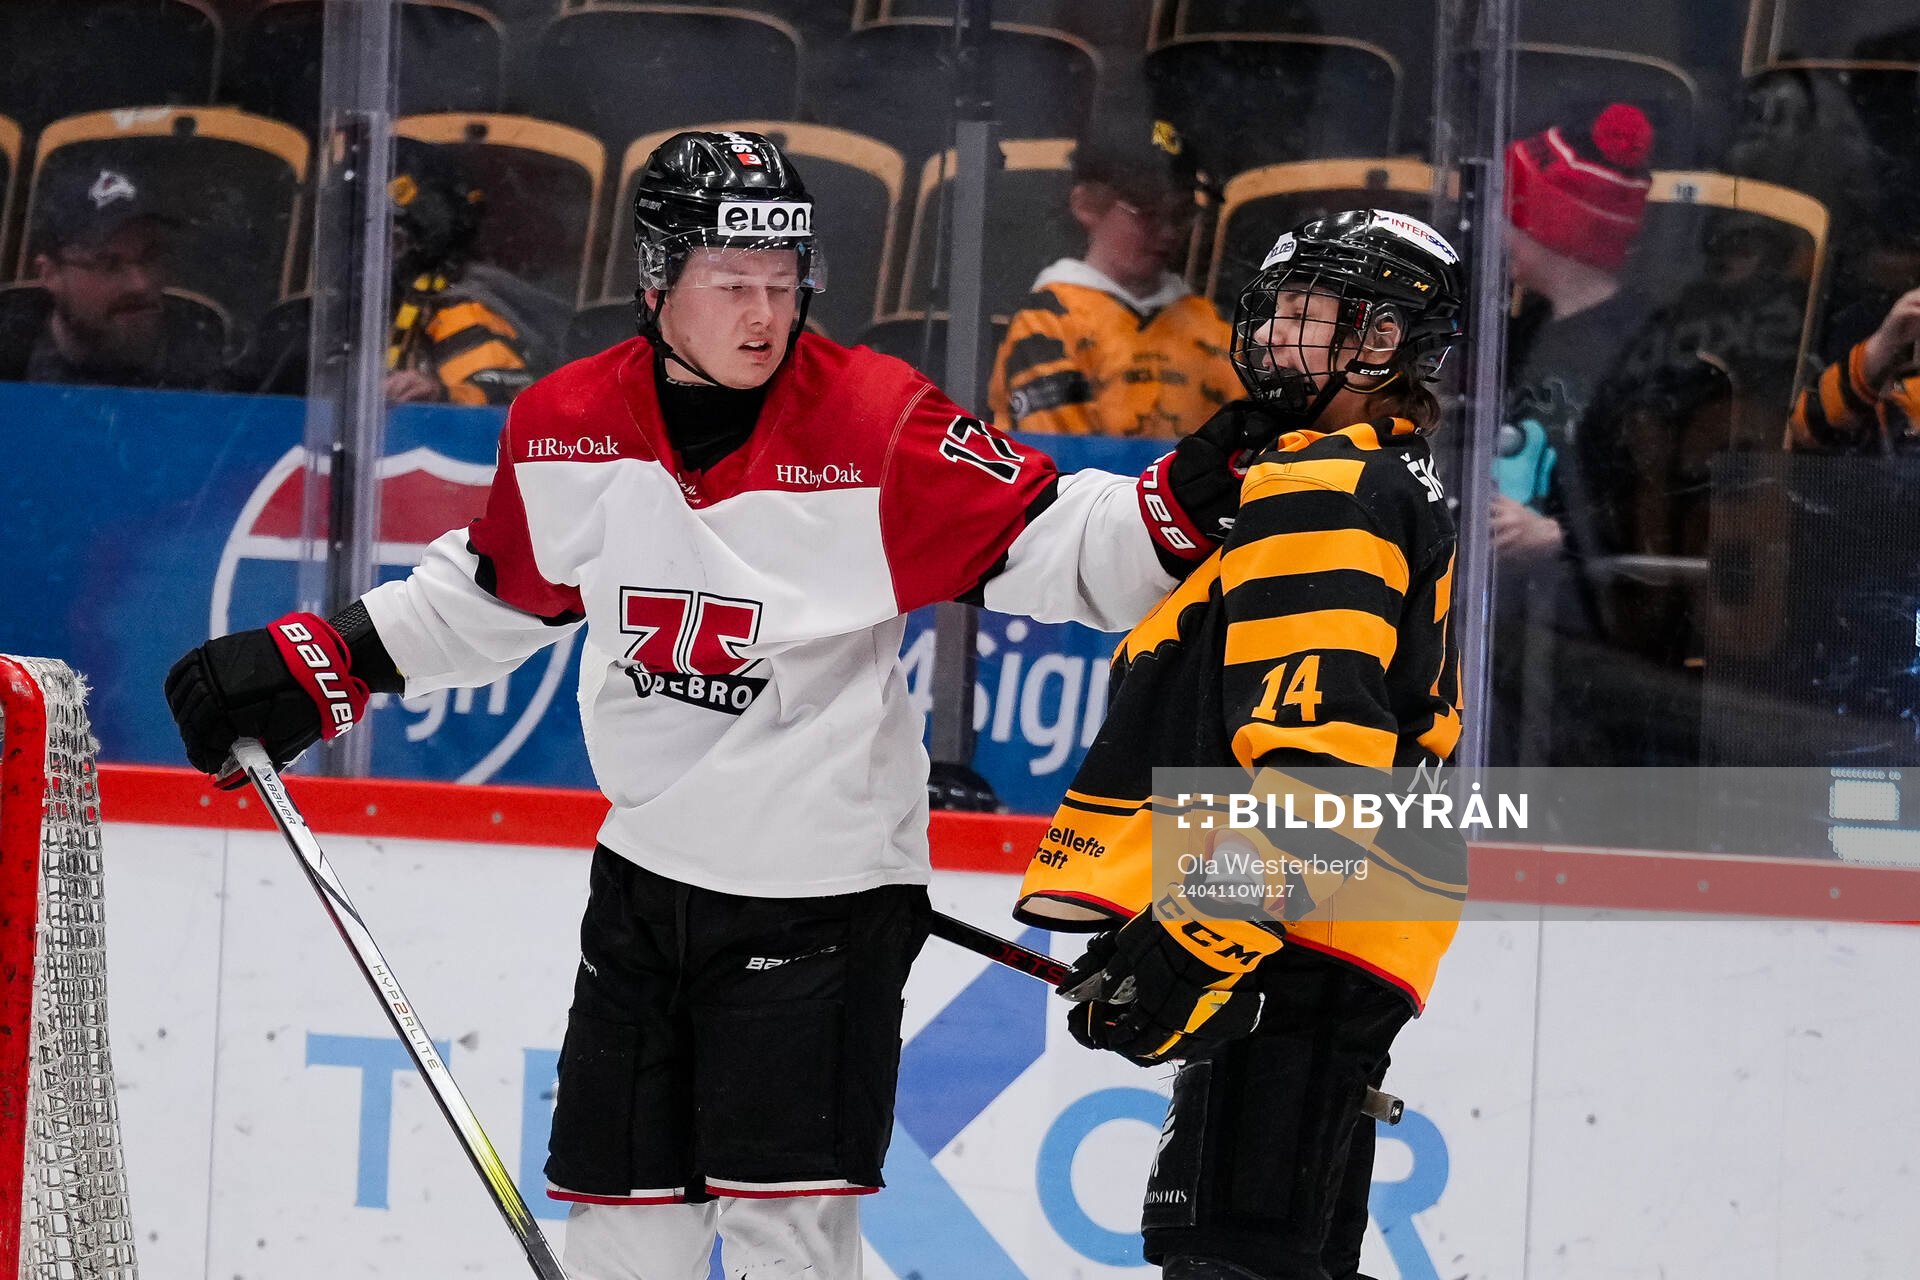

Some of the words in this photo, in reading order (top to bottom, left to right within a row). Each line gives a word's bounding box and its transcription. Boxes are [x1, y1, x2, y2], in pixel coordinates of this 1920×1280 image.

[1359, 367, 1390, 376] CCM
[526, 435, 620, 458] HRbyOak
[939, 415, 1026, 485] 17
[775, 462, 864, 485] HRbyOak
[1142, 449, 1197, 550] BAU
[1251, 655, 1323, 721] 14
[1033, 847, 1069, 870] raft
[1156, 892, 1263, 966] CCM
